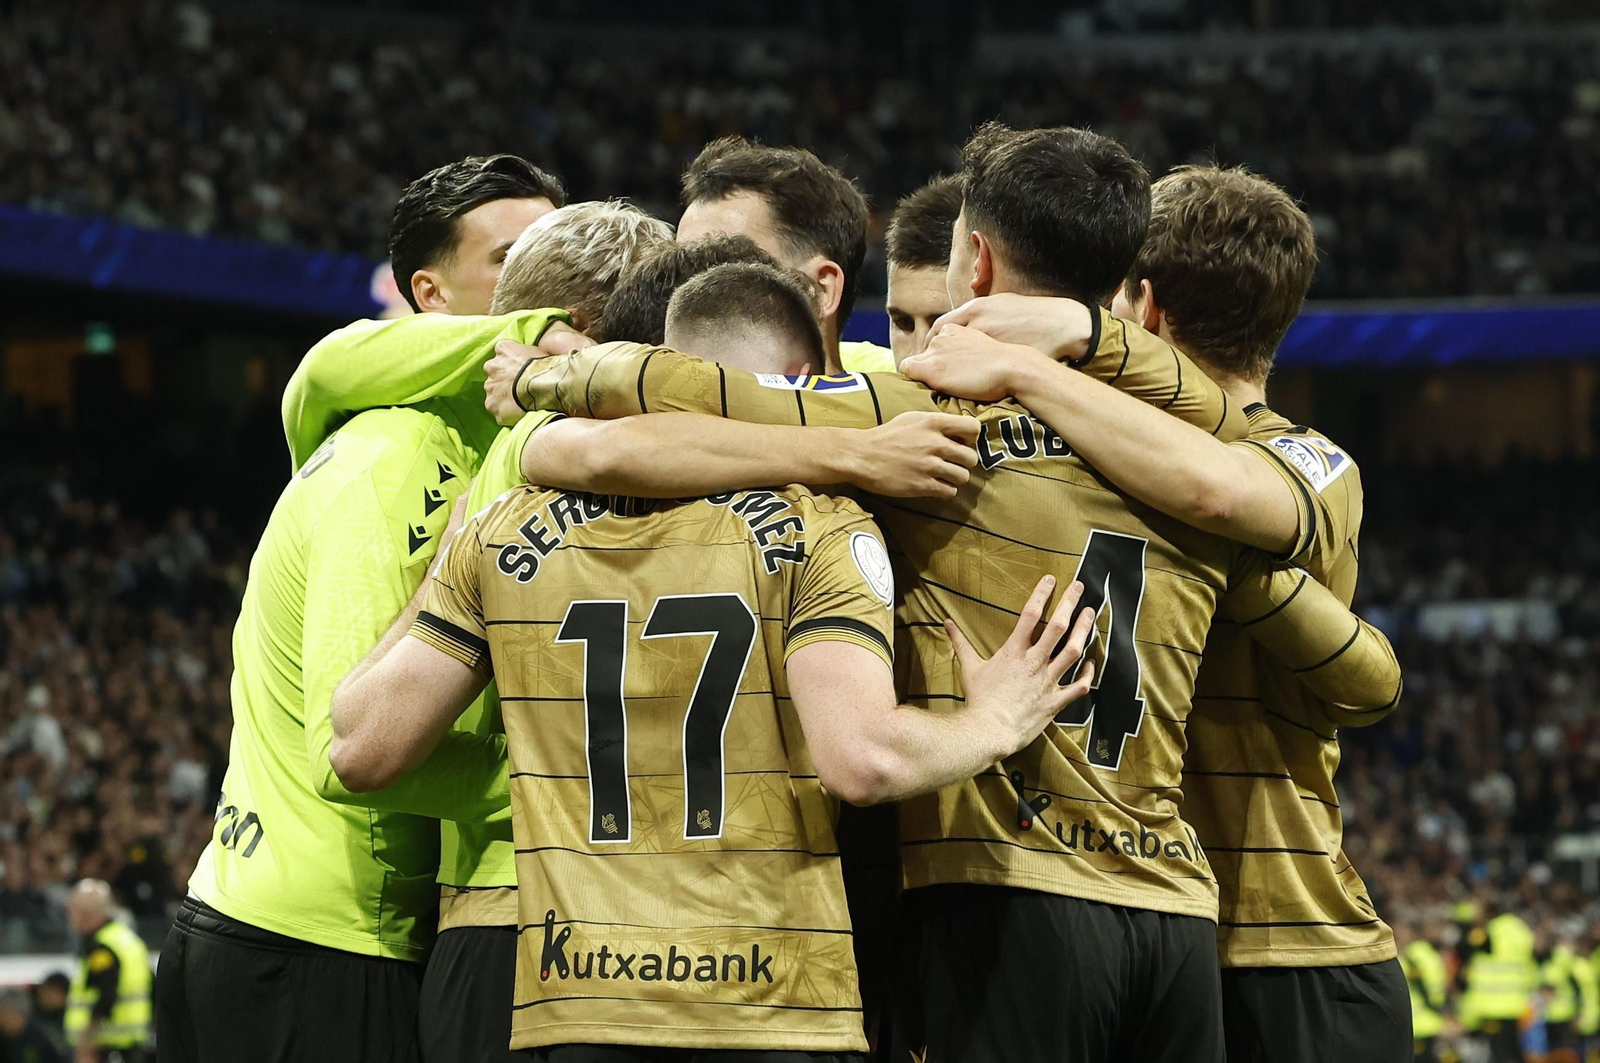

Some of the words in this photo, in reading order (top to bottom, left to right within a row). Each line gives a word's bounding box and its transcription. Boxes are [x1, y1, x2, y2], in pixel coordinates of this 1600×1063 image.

[674, 491, 805, 575] MEZ
[553, 592, 759, 844] 17
[1048, 528, 1149, 771] 4
[539, 909, 774, 984] Kutxabank
